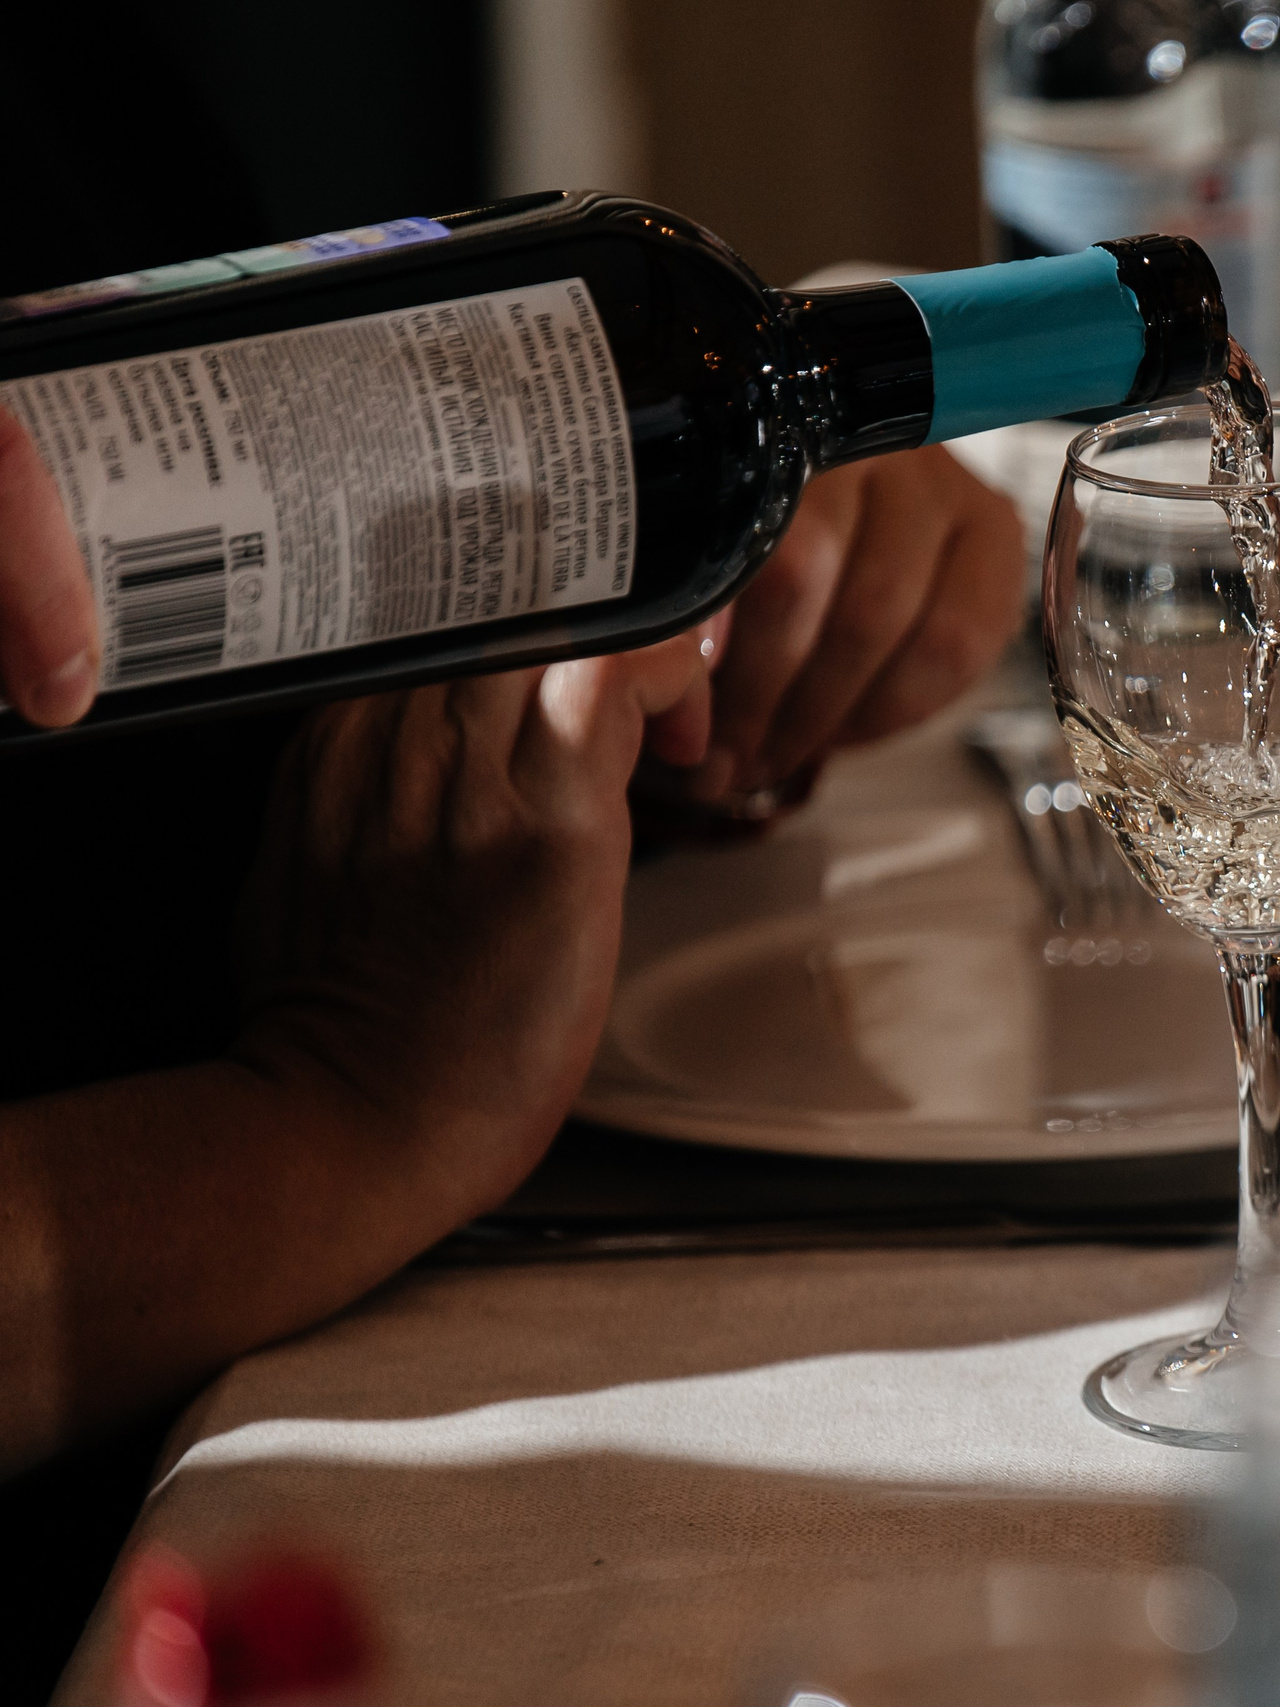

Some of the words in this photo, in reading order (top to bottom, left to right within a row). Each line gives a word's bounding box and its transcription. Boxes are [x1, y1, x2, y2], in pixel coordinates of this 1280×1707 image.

[506, 301, 543, 371] Кастилья
[533, 313, 558, 351] Вино
[588, 335, 608, 373] SANTA
[434, 307, 467, 348] МЕСТО
[451, 349, 499, 477] ПРОИСХОЖДЕНИЯ
[546, 353, 577, 426] сортовое
[599, 375, 620, 431] BARBARA
[532, 373, 561, 455] категория
[580, 395, 601, 435] Санта
[563, 429, 585, 475] сухое
[587, 438, 609, 496] Барбара
[610, 433, 627, 487] VERDEJO
[550, 457, 569, 497] VINO
[572, 477, 589, 524] белое
[454, 486, 478, 520] ГОД
[553, 501, 569, 521] DE
[459, 521, 479, 586] УРОЖАЯ
[554, 523, 571, 543] LA
[574, 528, 587, 578] регион
[617, 521, 629, 549] VINO
[550, 546, 570, 593] TIERRA
